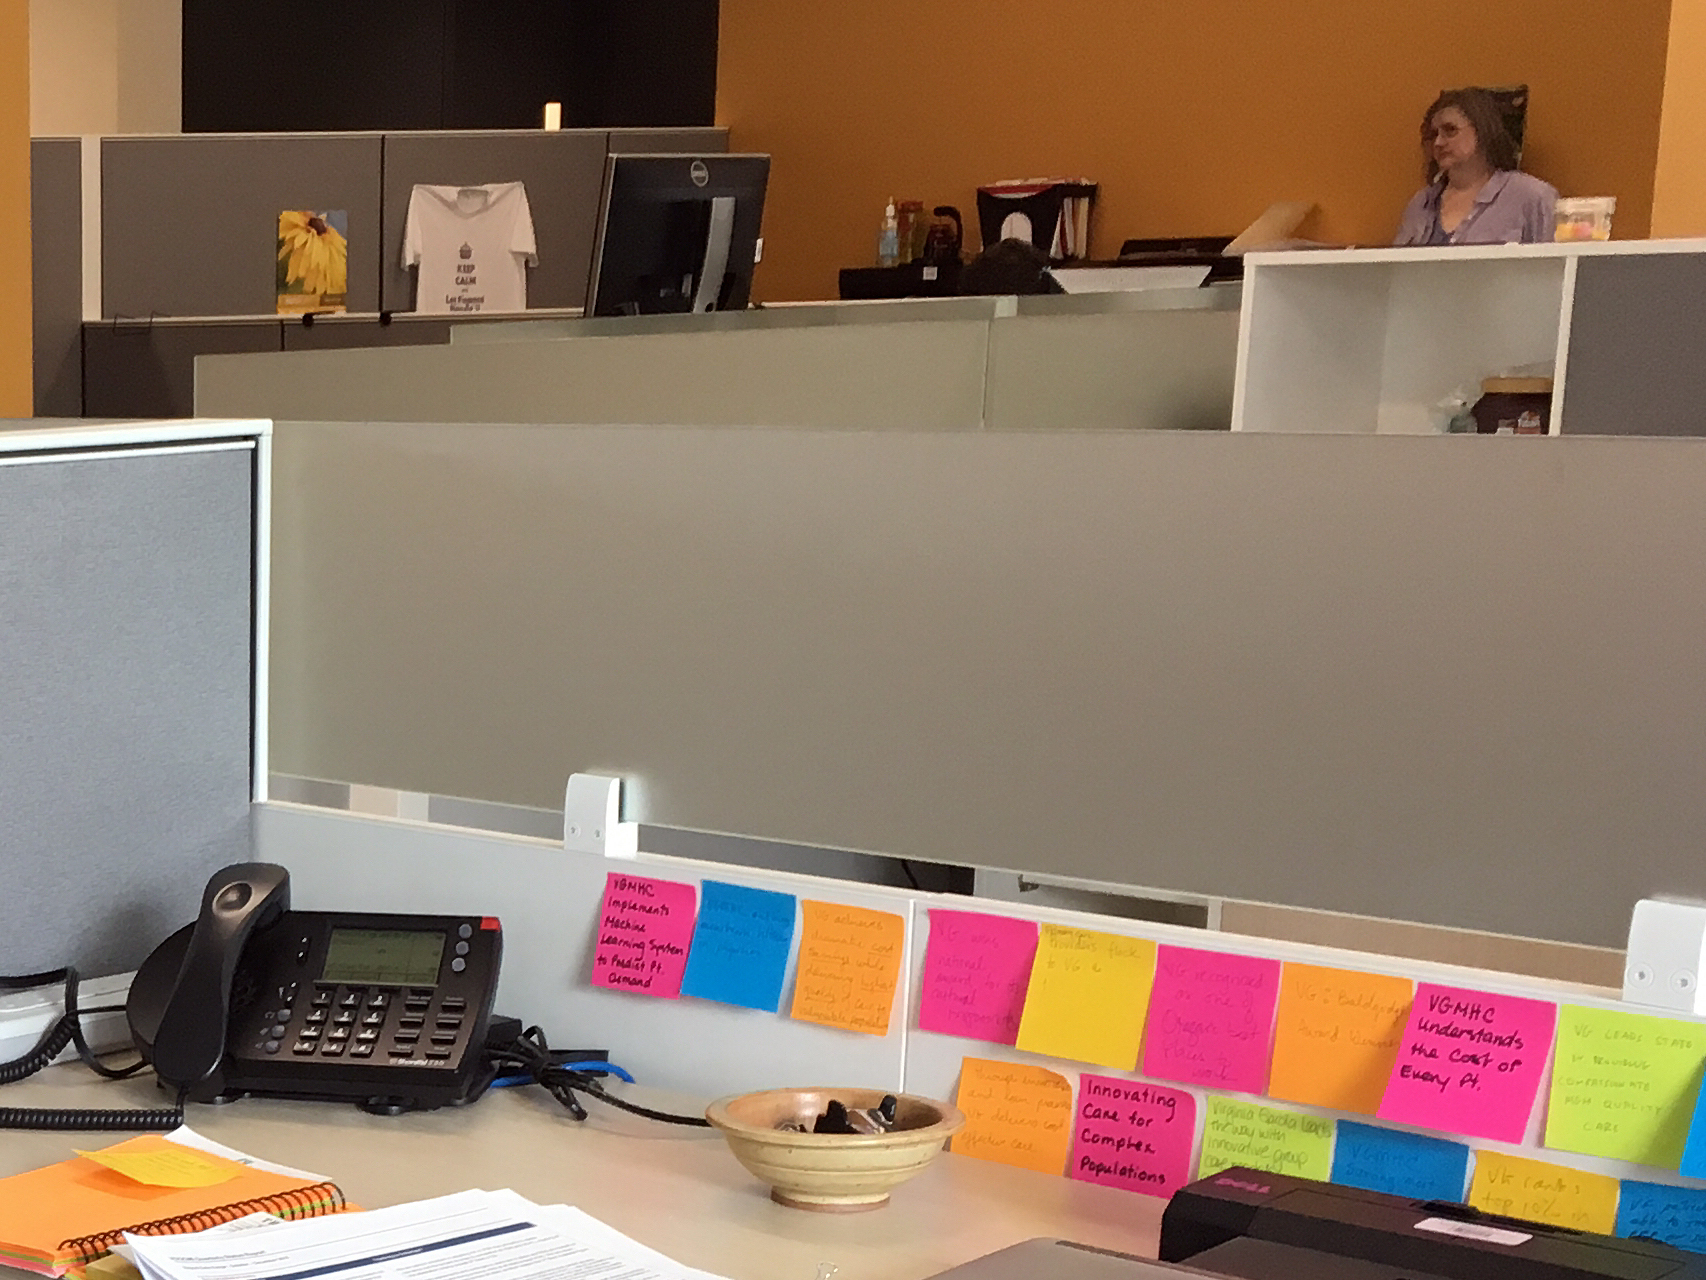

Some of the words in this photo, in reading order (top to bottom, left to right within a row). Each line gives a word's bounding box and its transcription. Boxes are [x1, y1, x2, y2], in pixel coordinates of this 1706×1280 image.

[457, 264, 475, 274] KEEP
[597, 953, 607, 966] to
[1429, 994, 1496, 1024] VGMHC
[1604, 1029, 1643, 1042] LEADS
[1400, 1065, 1451, 1093] Every
[1087, 1079, 1177, 1123] Innovating
[1082, 1102, 1120, 1122] Care
[1128, 1110, 1154, 1128] for
[1583, 1121, 1620, 1134] CARE
[1081, 1128, 1156, 1155] Complex
[1080, 1155, 1166, 1185] Populations
[1481, 1191, 1514, 1214] top
[1522, 1198, 1561, 1218] 10%
